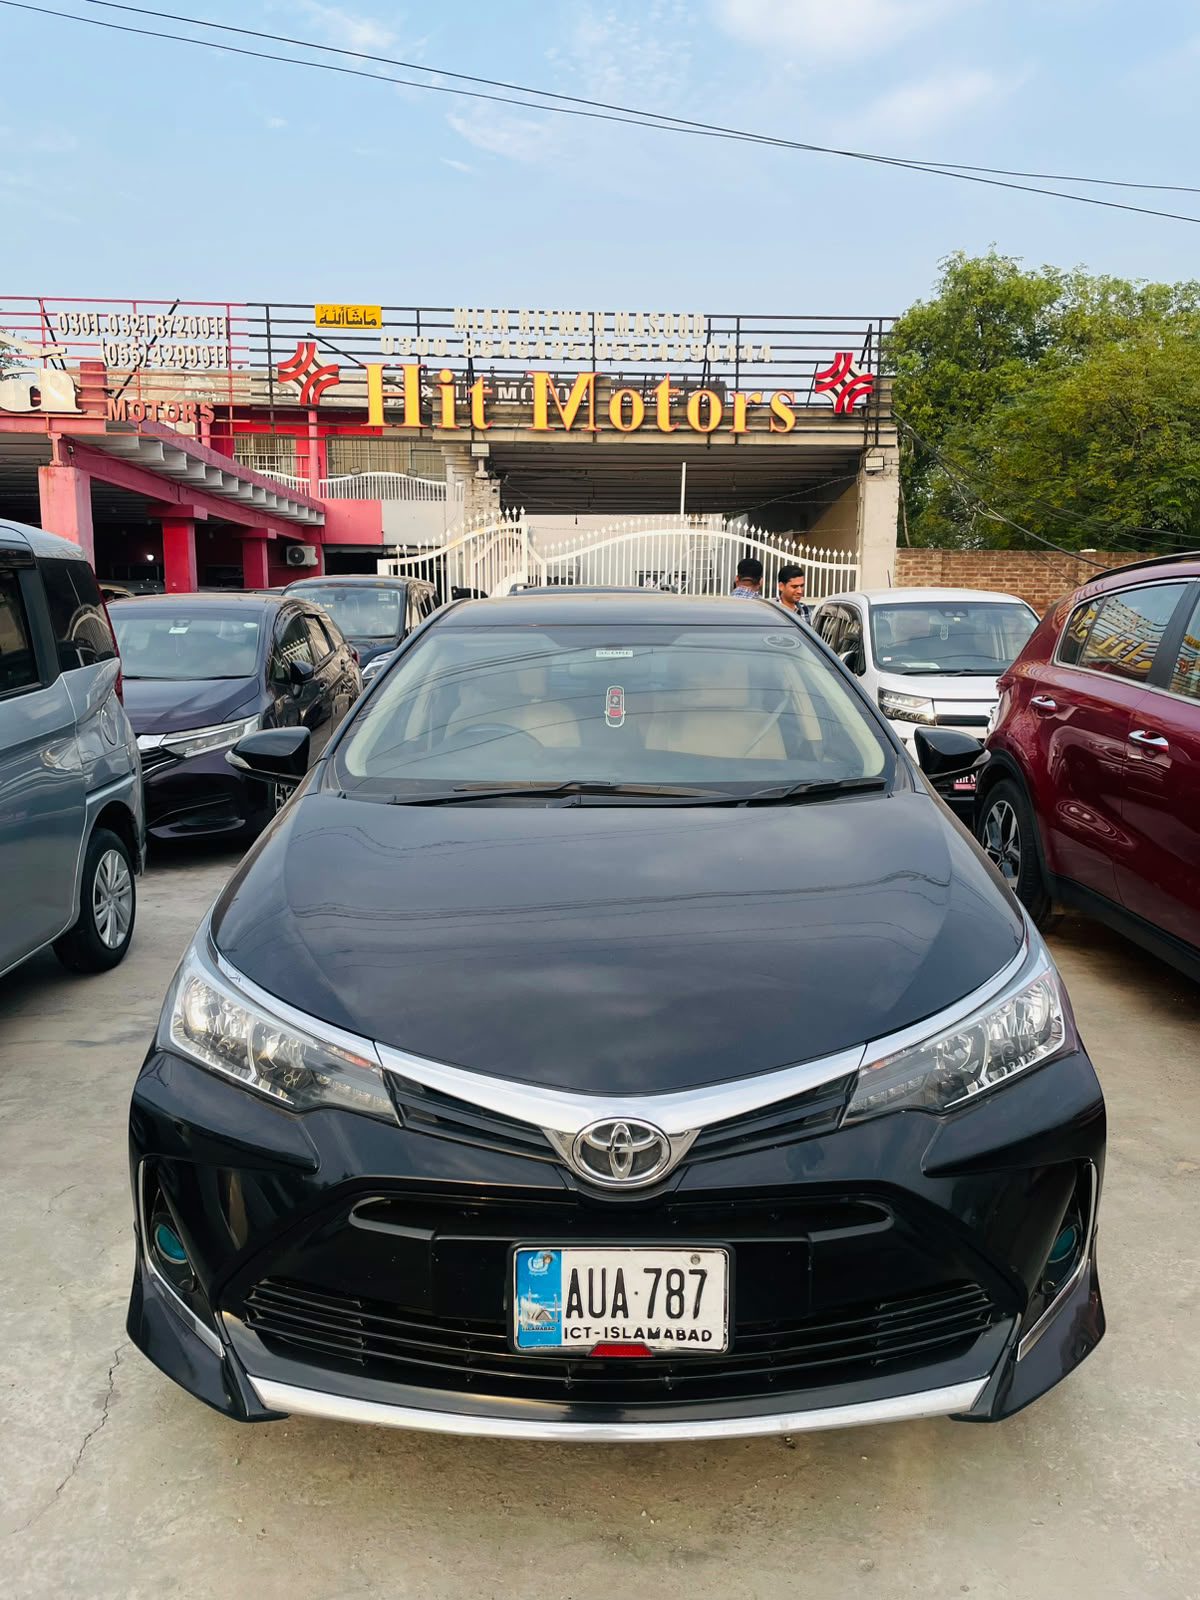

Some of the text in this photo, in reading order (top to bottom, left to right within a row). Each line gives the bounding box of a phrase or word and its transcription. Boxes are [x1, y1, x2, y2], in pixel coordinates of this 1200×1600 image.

[518, 309, 605, 337] RIZWAN
[614, 312, 705, 339] MASOOD
[107, 398, 216, 425] MOTORS
[359, 363, 797, 433] Hit Motors
